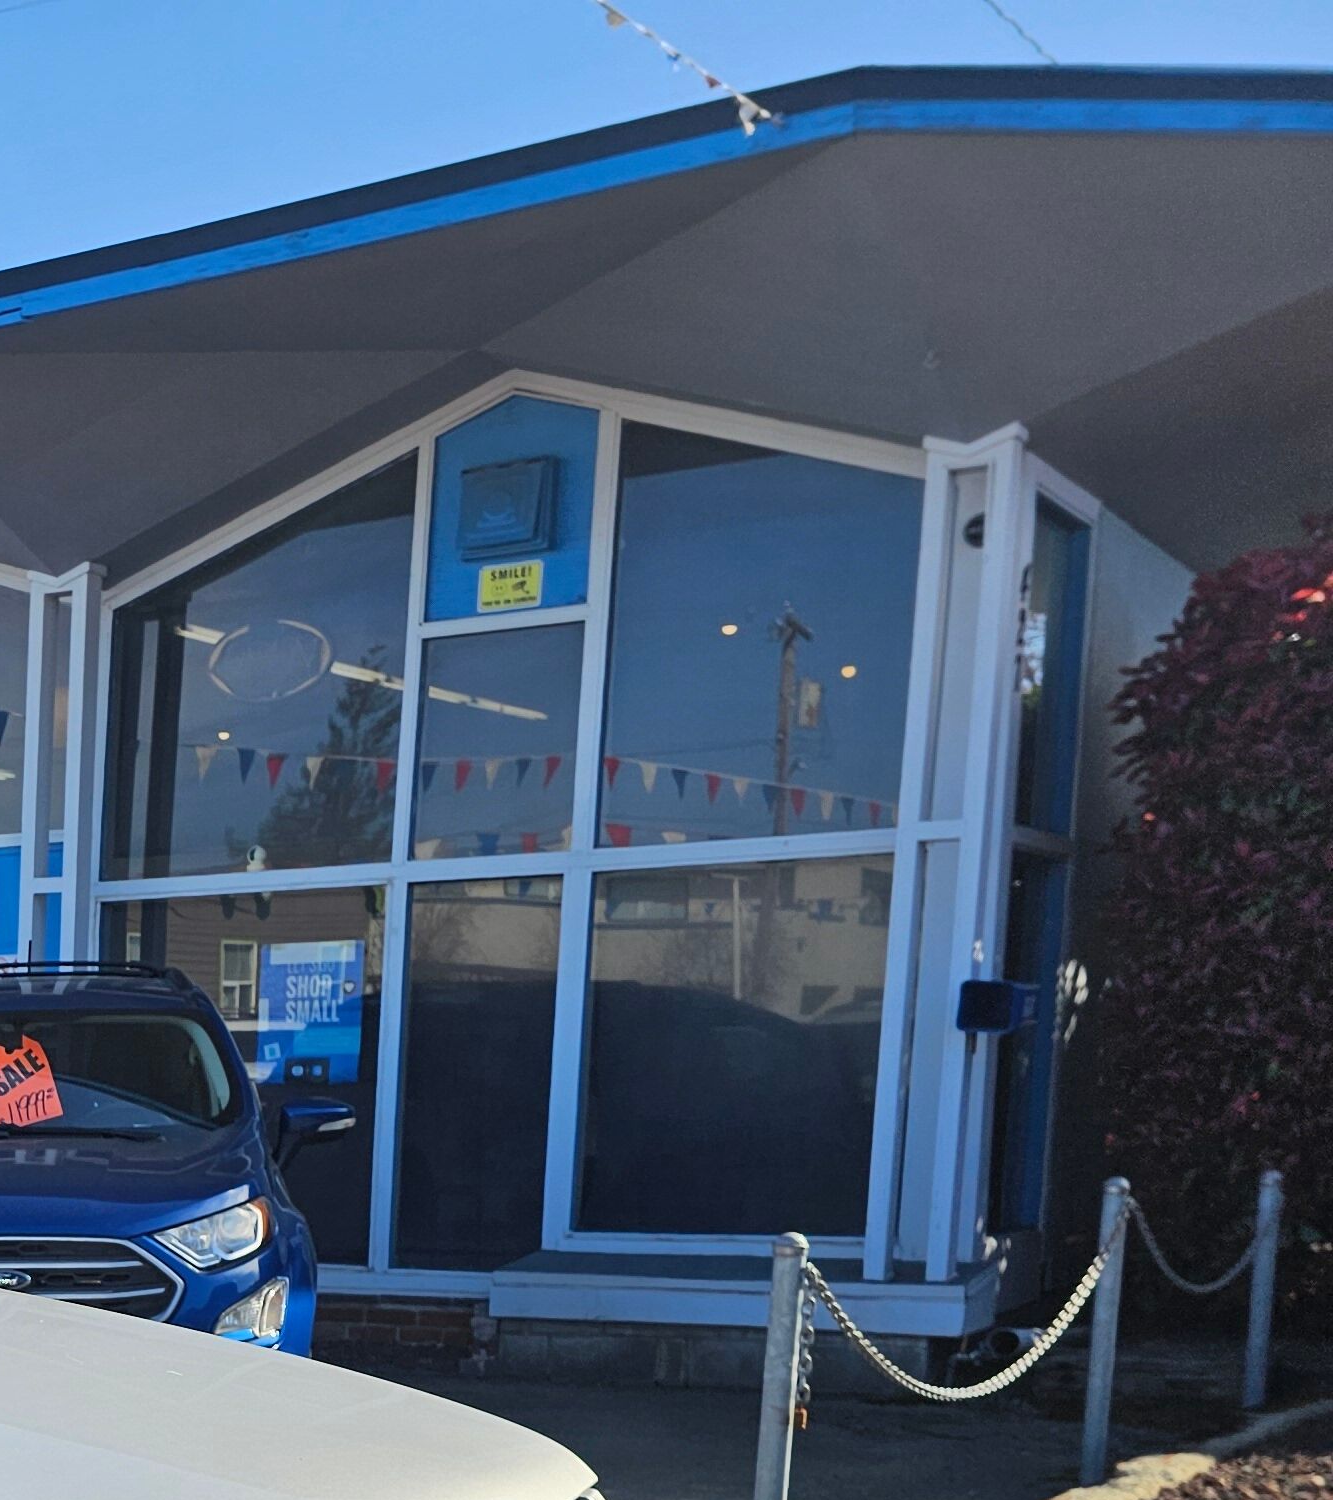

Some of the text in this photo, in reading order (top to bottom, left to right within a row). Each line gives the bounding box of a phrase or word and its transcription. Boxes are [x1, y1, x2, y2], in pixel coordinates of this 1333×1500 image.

[490, 565, 532, 581] SMILE!
[286, 974, 332, 999] SHOP
[285, 999, 340, 1024] SMALL
